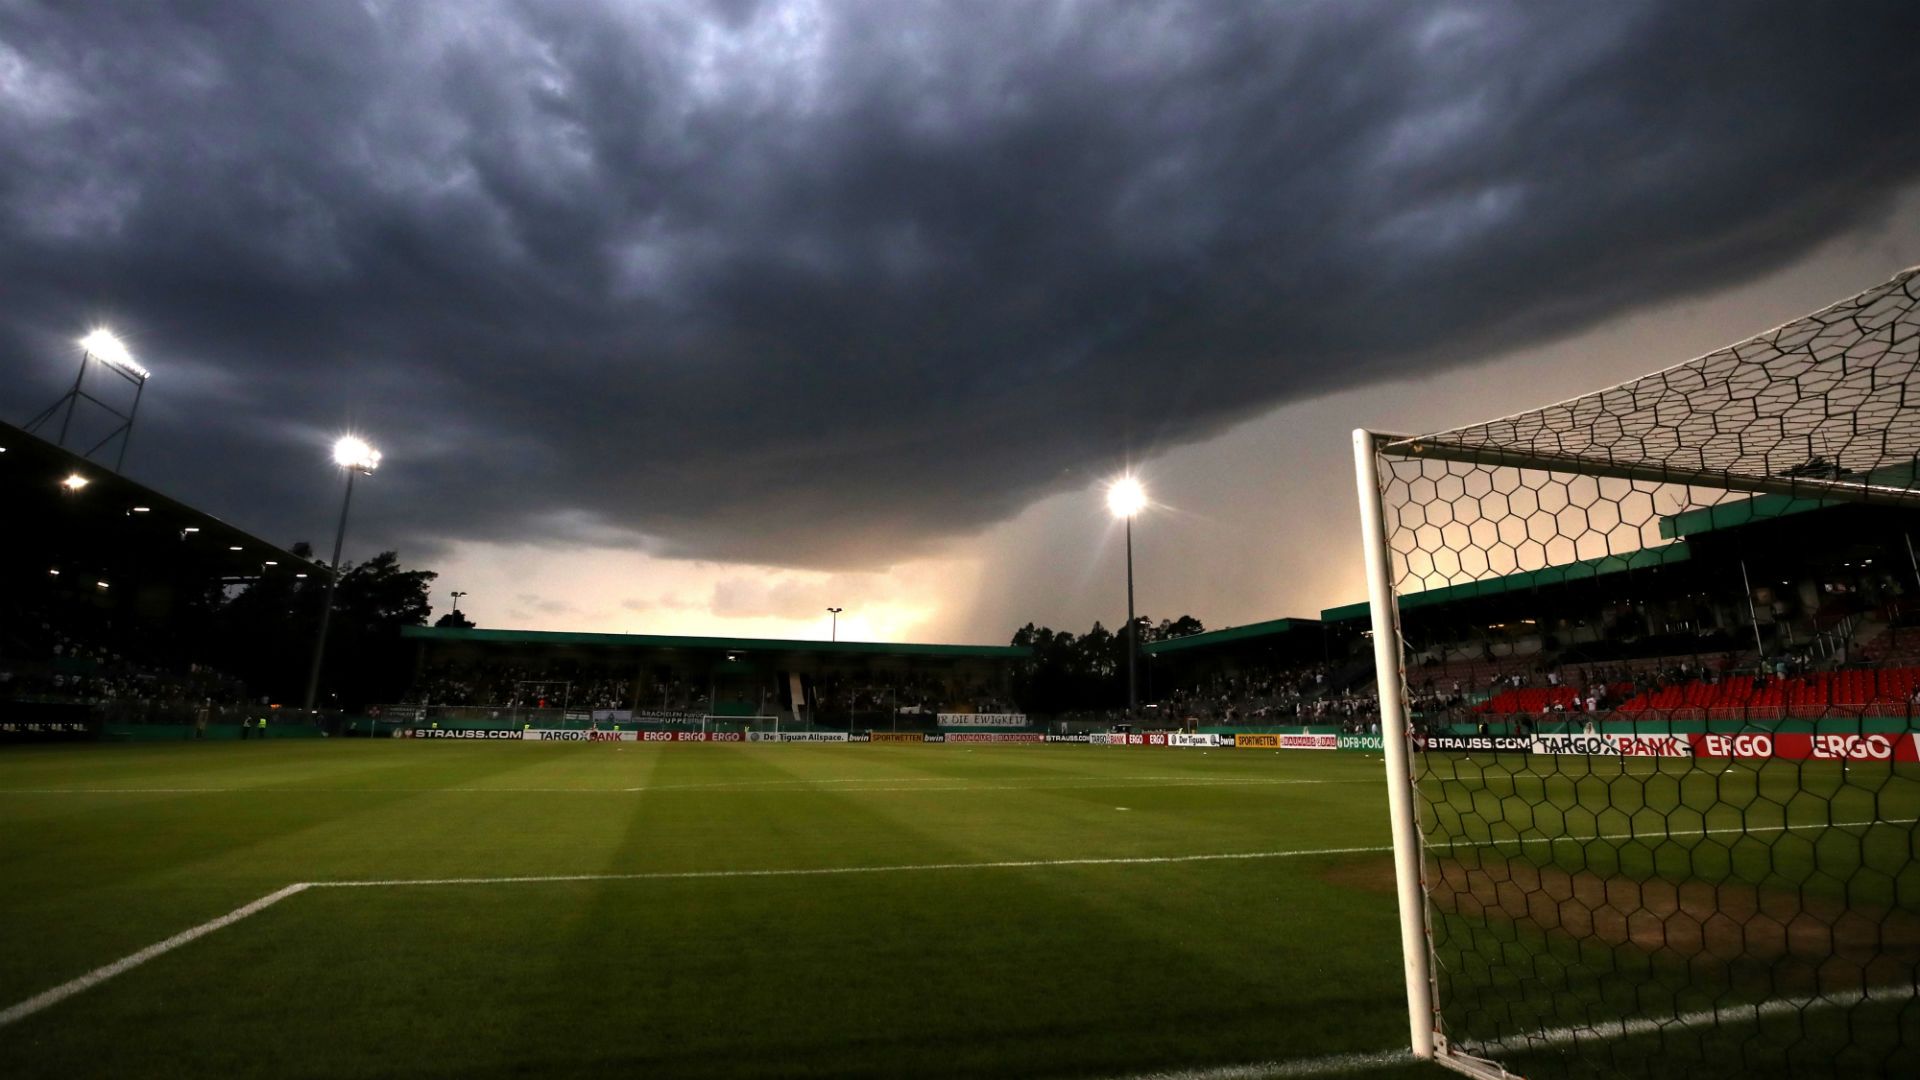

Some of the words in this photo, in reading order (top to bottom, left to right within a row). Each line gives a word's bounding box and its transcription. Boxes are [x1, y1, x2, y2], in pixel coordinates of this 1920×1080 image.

[951, 714, 969, 724] DIE
[415, 730, 522, 739] STRAUSS.COM
[643, 732, 672, 741] ERGO
[678, 732, 706, 741] ERGO
[711, 732, 740, 741] ERGO
[780, 733, 807, 742] Tiguan
[808, 733, 844, 742] Allspace.
[849, 734, 869, 742] bwin
[872, 734, 922, 742] SPORTWETTEN
[924, 734, 944, 742] bwin
[1129, 735, 1143, 744] ERGO
[1150, 735, 1164, 744] ERGO
[1179, 736, 1188, 744] Der
[1220, 736, 1235, 745] bwin
[1239, 736, 1277, 746] SPORTWETTEN
[1428, 738, 1530, 749] STRAUSS.COM
[1705, 735, 1773, 757] ERGO
[1810, 735, 1892, 758] ERGO
